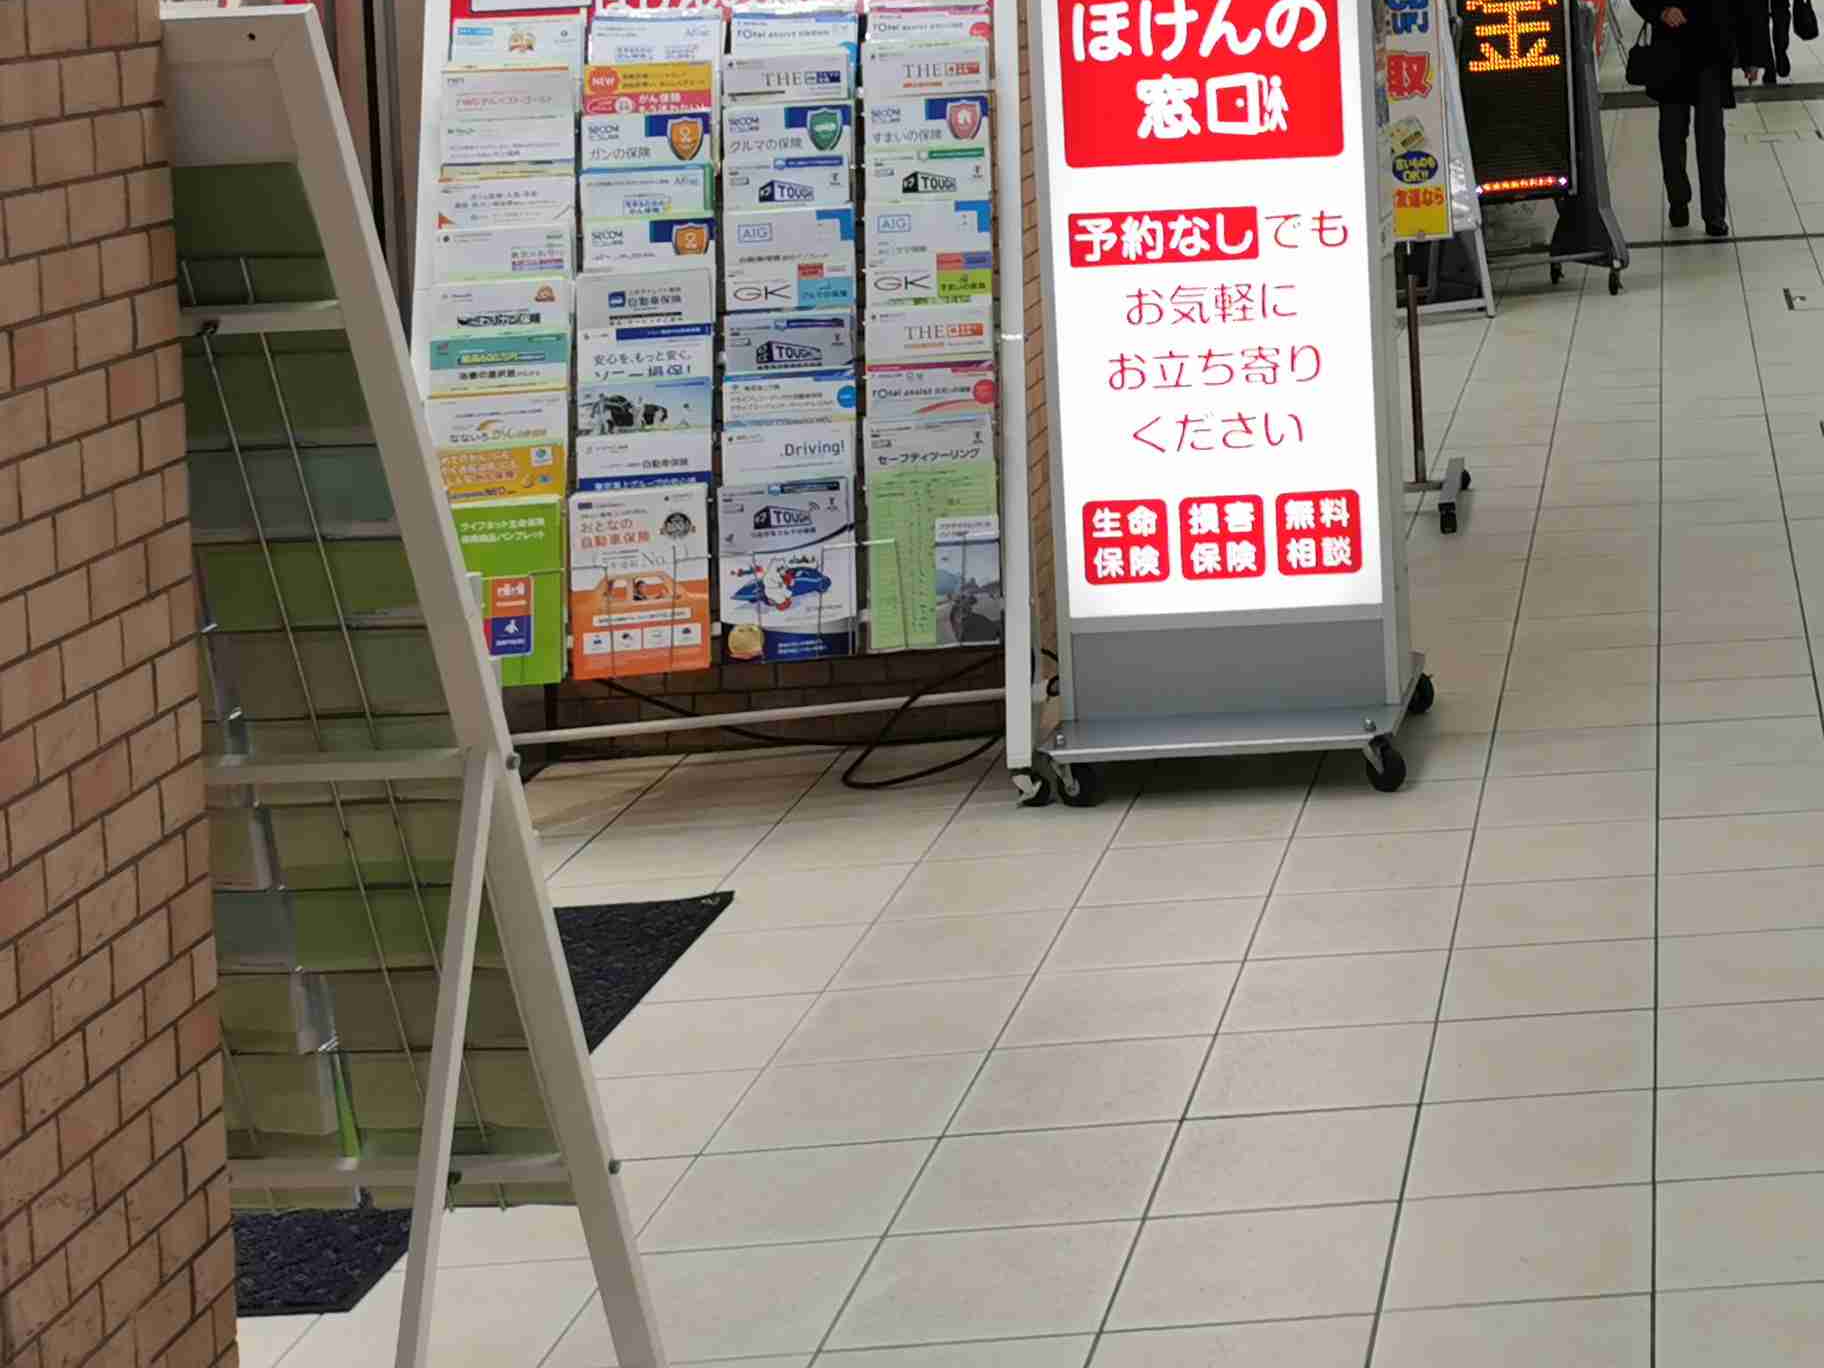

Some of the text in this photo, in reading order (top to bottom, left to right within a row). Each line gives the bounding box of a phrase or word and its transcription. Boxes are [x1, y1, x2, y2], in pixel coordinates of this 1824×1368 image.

[1135, 72, 1268, 140] 窓口
[872, 129, 943, 144] すまいの保険
[590, 146, 651, 161] ガンの保険
[729, 138, 803, 153] クルマの保険
[742, 226, 769, 239] AIG
[880, 217, 909, 231] AIG
[873, 274, 931, 292] GK
[733, 284, 793, 302] GK
[628, 295, 683, 309] 自動車保険
[1124, 281, 1299, 328] お気軽に
[1107, 344, 1321, 391] お立ち寄り
[1131, 411, 1305, 454] ください
[641, 457, 689, 469] 自動車保険
[877, 448, 980, 466] セーフティツーリング
[580, 517, 634, 533] おとなの
[1091, 496, 1350, 540] 生命 損害 無料
[580, 532, 650, 549] 自動車保険
[1092, 536, 1353, 579] 保険 保険 相談
